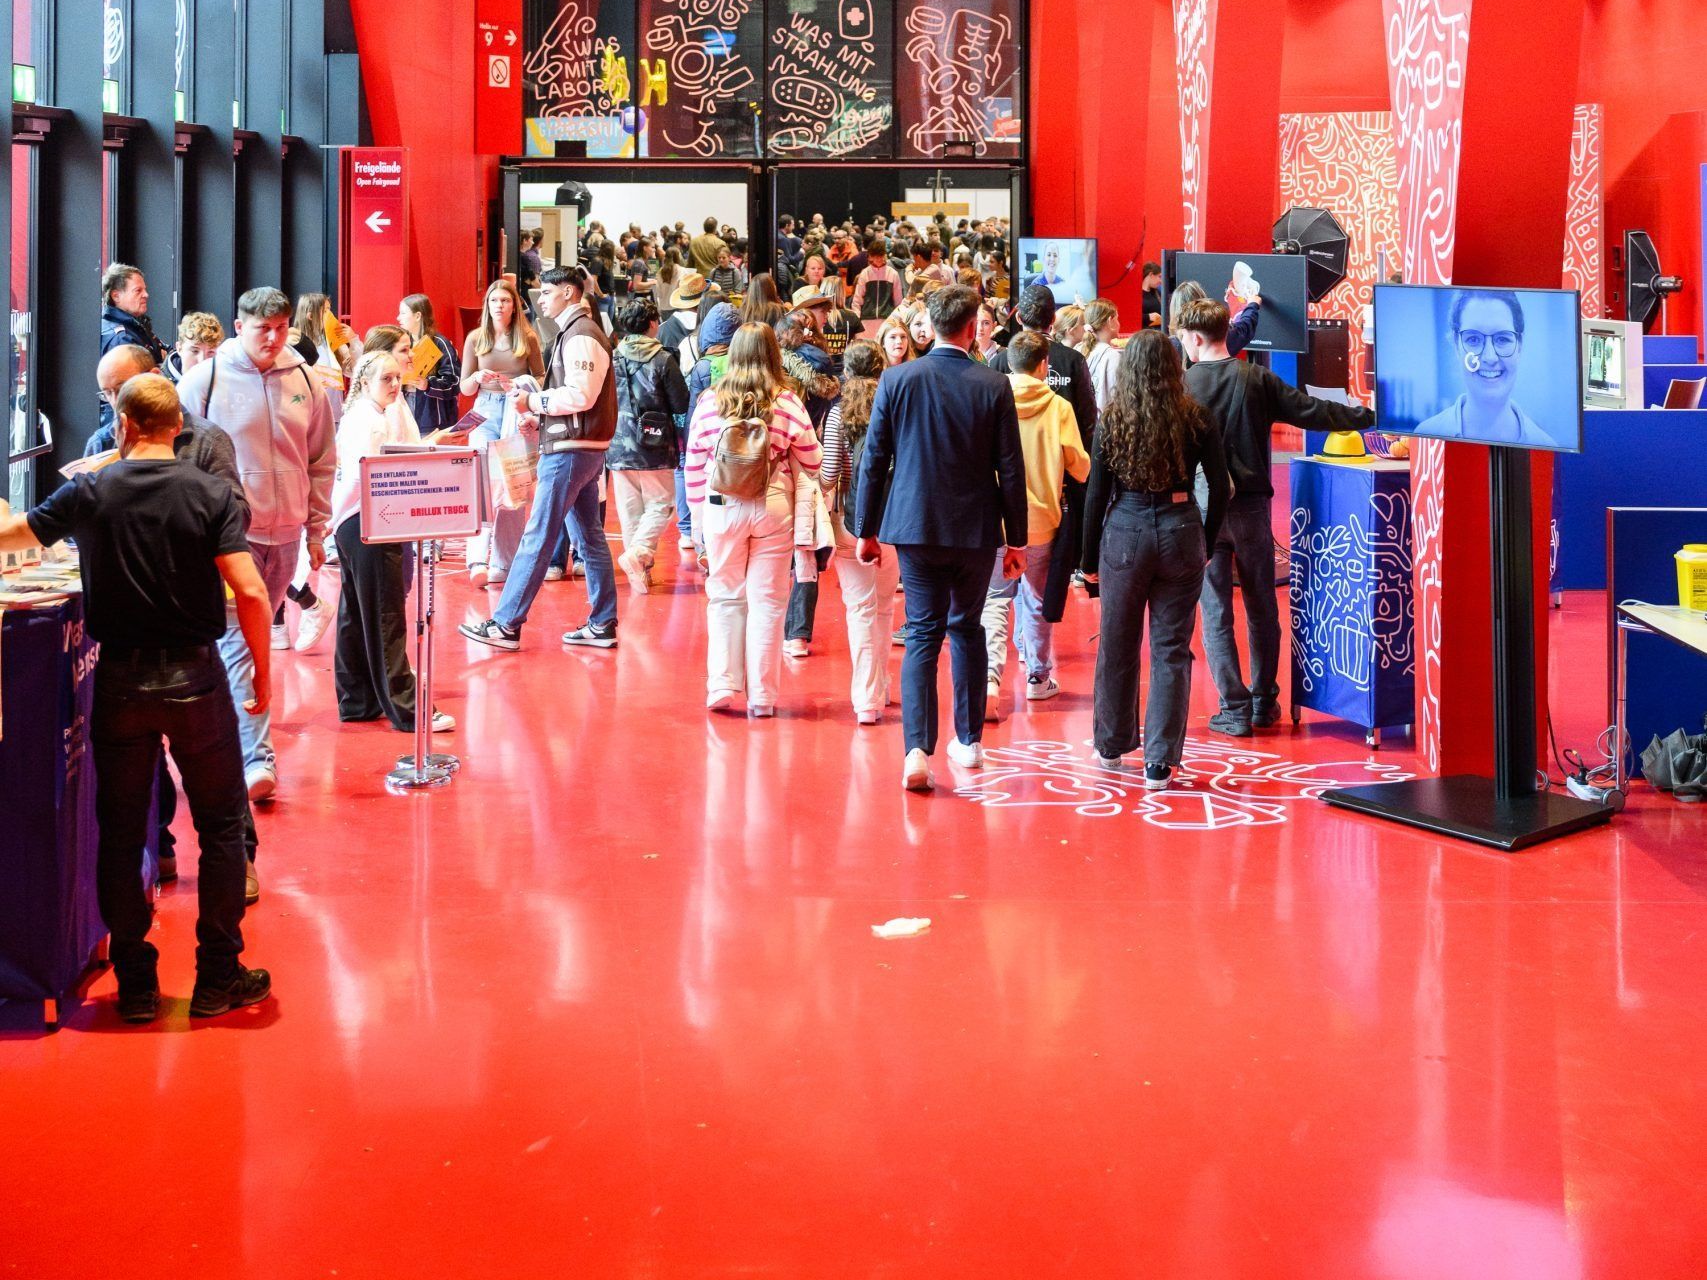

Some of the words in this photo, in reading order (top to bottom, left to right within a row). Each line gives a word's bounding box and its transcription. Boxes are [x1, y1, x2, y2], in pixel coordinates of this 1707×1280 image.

[485, 32, 493, 46] 9
[573, 36, 620, 56] WAS
[791, 12, 832, 48] WAS
[837, 44, 875, 74] MIT
[564, 59, 597, 79] MIT
[772, 27, 877, 102] STRAHLUNG
[534, 79, 606, 100] LABOR
[355, 161, 401, 176] Freigelände
[356, 178, 371, 187] Open
[644, 426, 662, 436] FILA
[411, 506, 441, 517] BRILLUX
[443, 505, 469, 515] TRUCK
